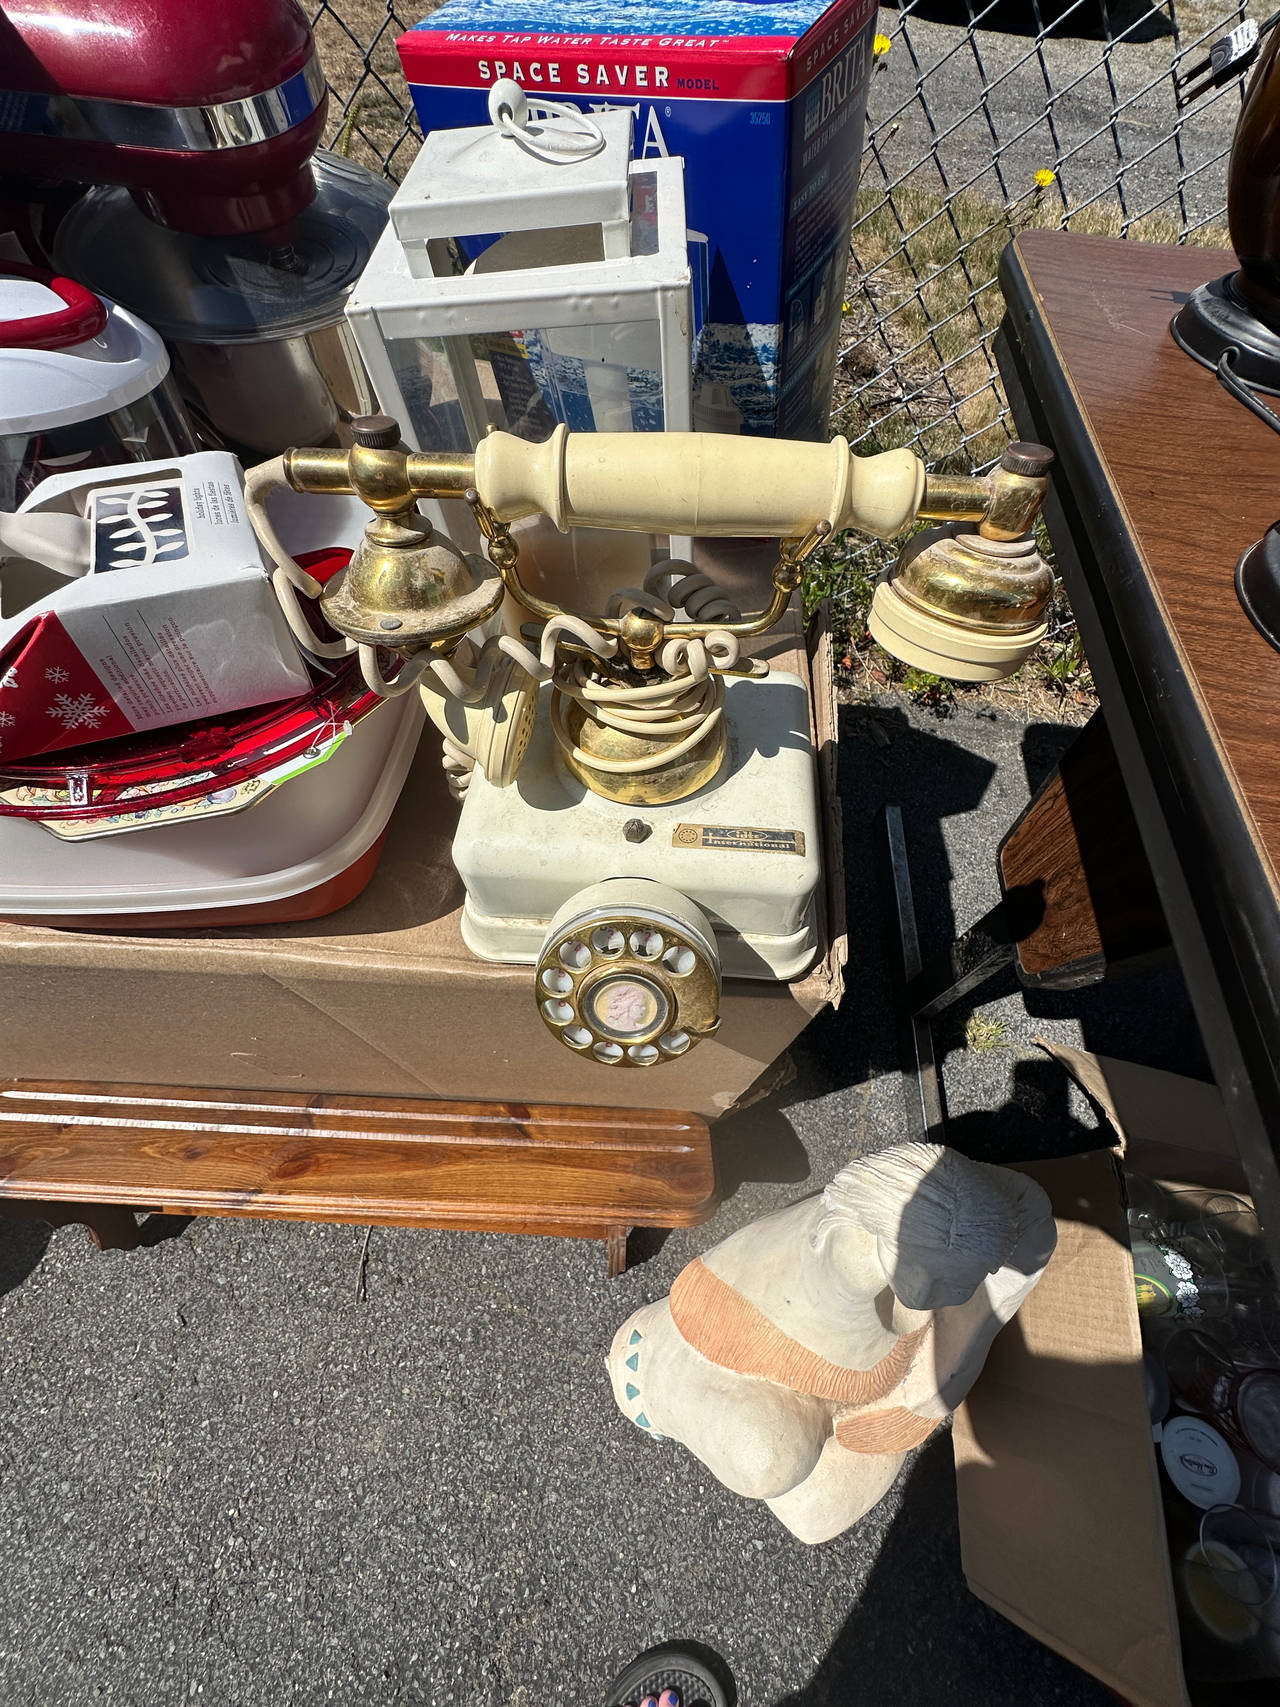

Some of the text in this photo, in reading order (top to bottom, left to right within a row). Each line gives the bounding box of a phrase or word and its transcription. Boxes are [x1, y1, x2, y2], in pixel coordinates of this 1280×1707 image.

[445, 33, 496, 43] MAKES
[501, 35, 532, 44] TAP
[537, 35, 593, 45] WATER
[600, 37, 652, 46] TASTE
[807, 28, 839, 72] SPACE
[478, 60, 719, 90] SPACE SAVER MODEL
[820, 33, 867, 126] BRITA
[708, 832, 790, 849] International
